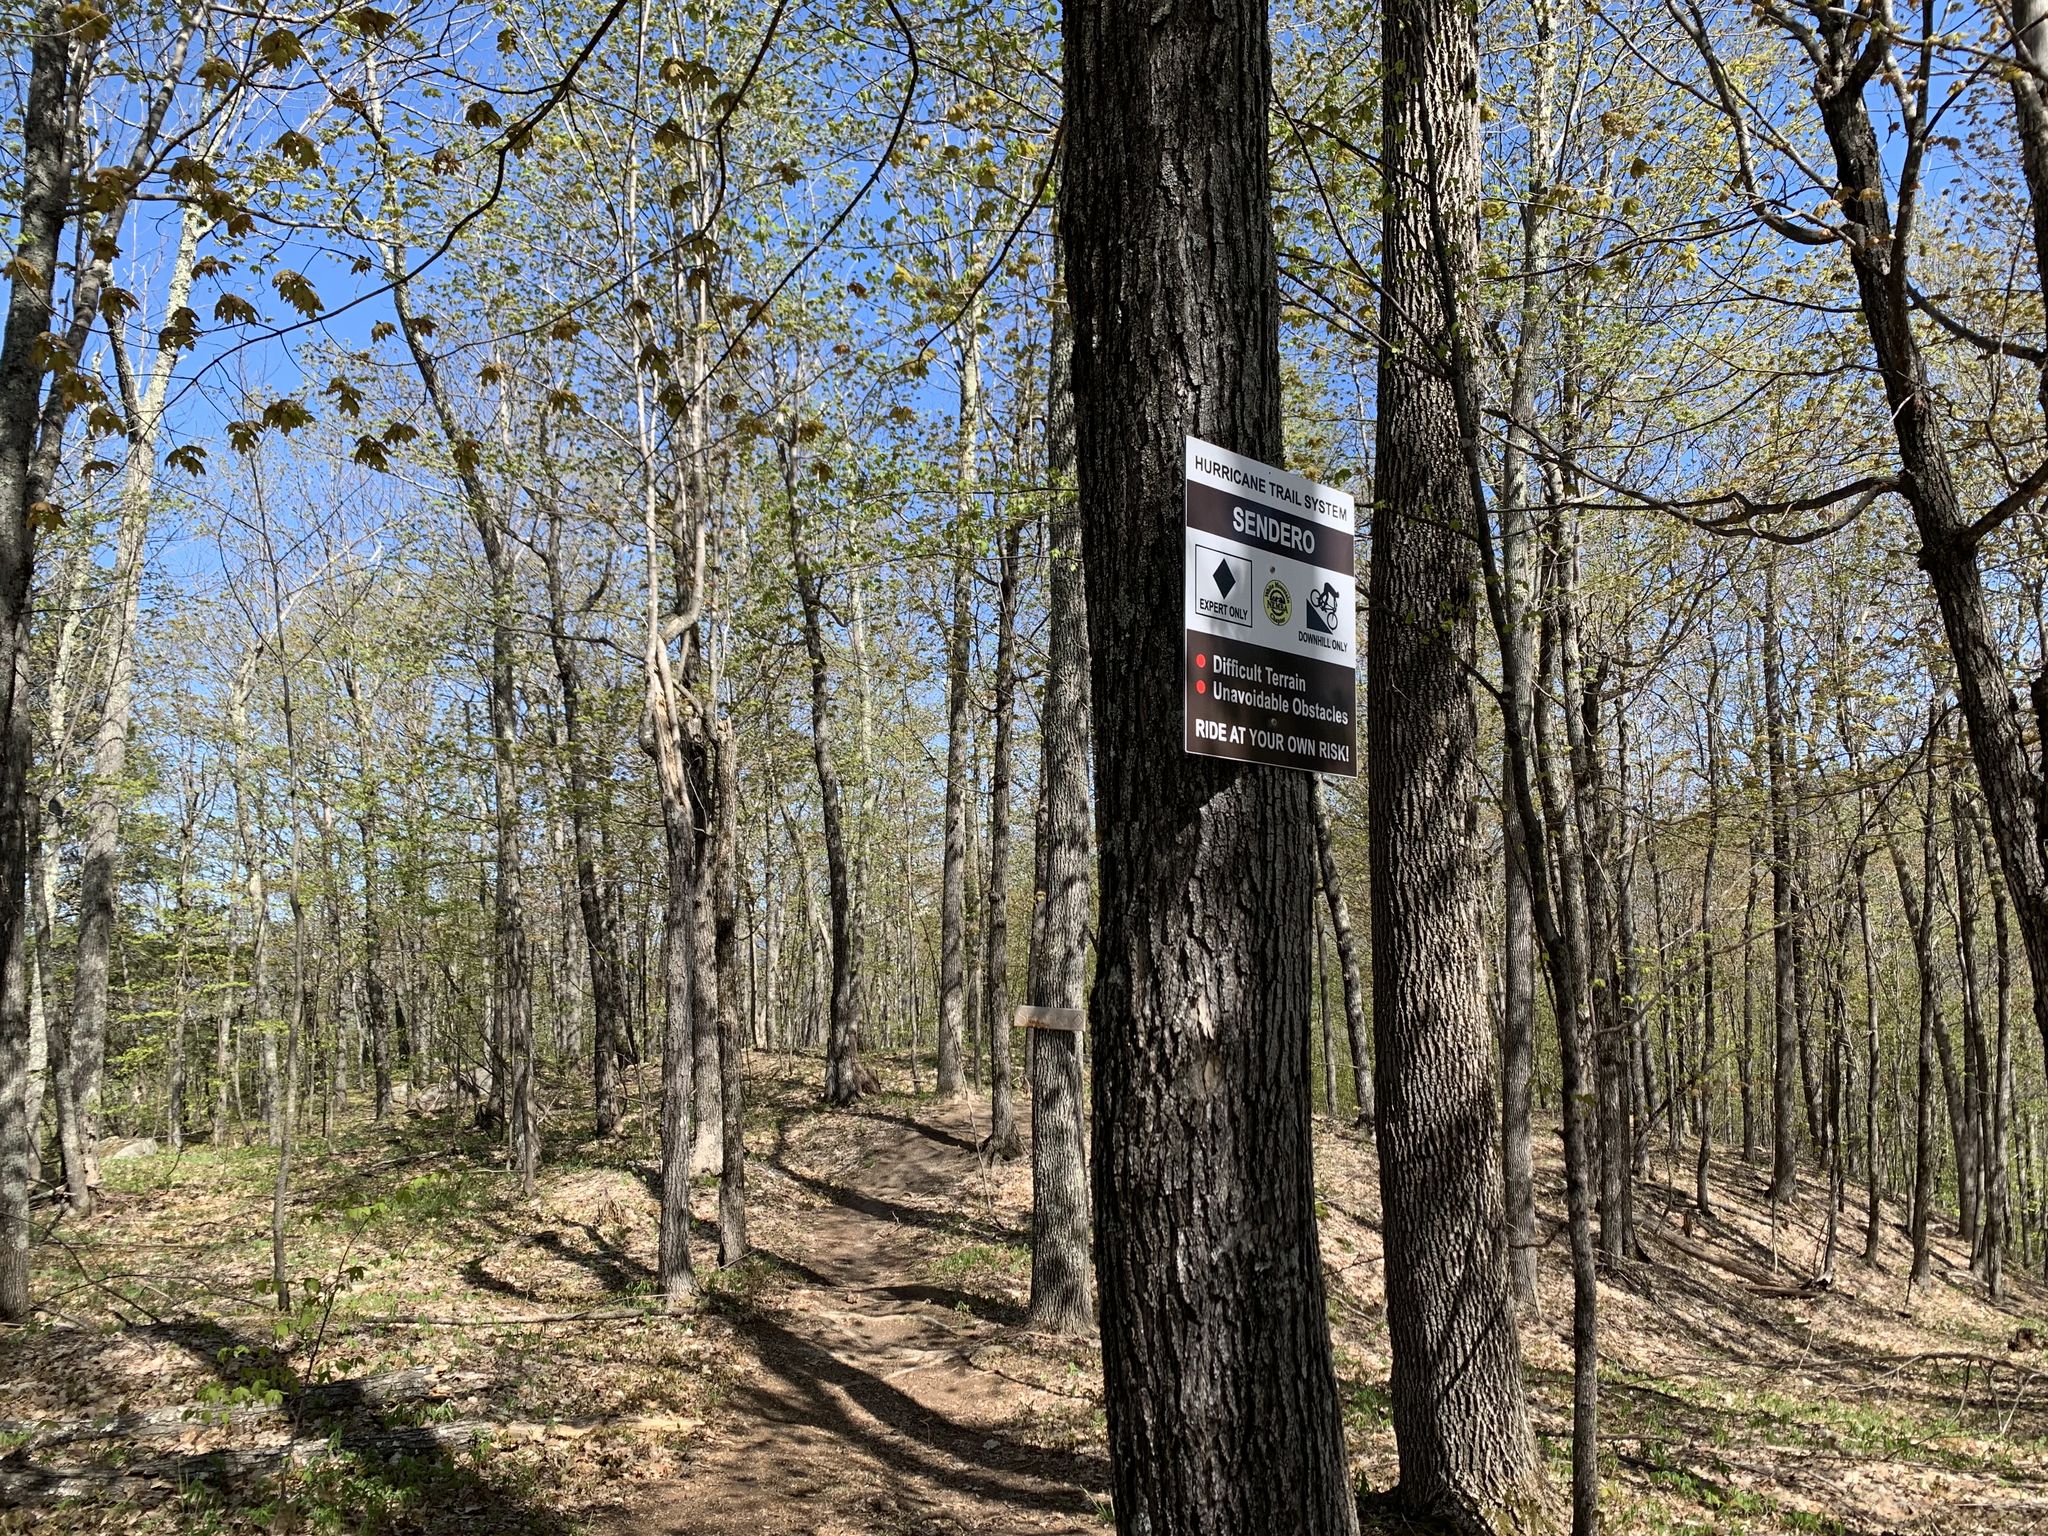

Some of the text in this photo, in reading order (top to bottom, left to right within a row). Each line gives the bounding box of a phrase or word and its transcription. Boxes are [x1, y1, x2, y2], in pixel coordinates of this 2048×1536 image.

[1195, 455, 1347, 521] HURRICANE TRAIL SYSTEM
[1232, 506, 1315, 554] SENDERO
[1200, 598, 1248, 620] EXPERT ONLY
[1298, 631, 1348, 652] DOWNHILL ONLY
[1213, 654, 1306, 692] Difficult Terrain
[1213, 680, 1349, 725] Unavoidable Obstacles
[1195, 718, 1349, 762] RIDE AT YOUR OWN RISK!
